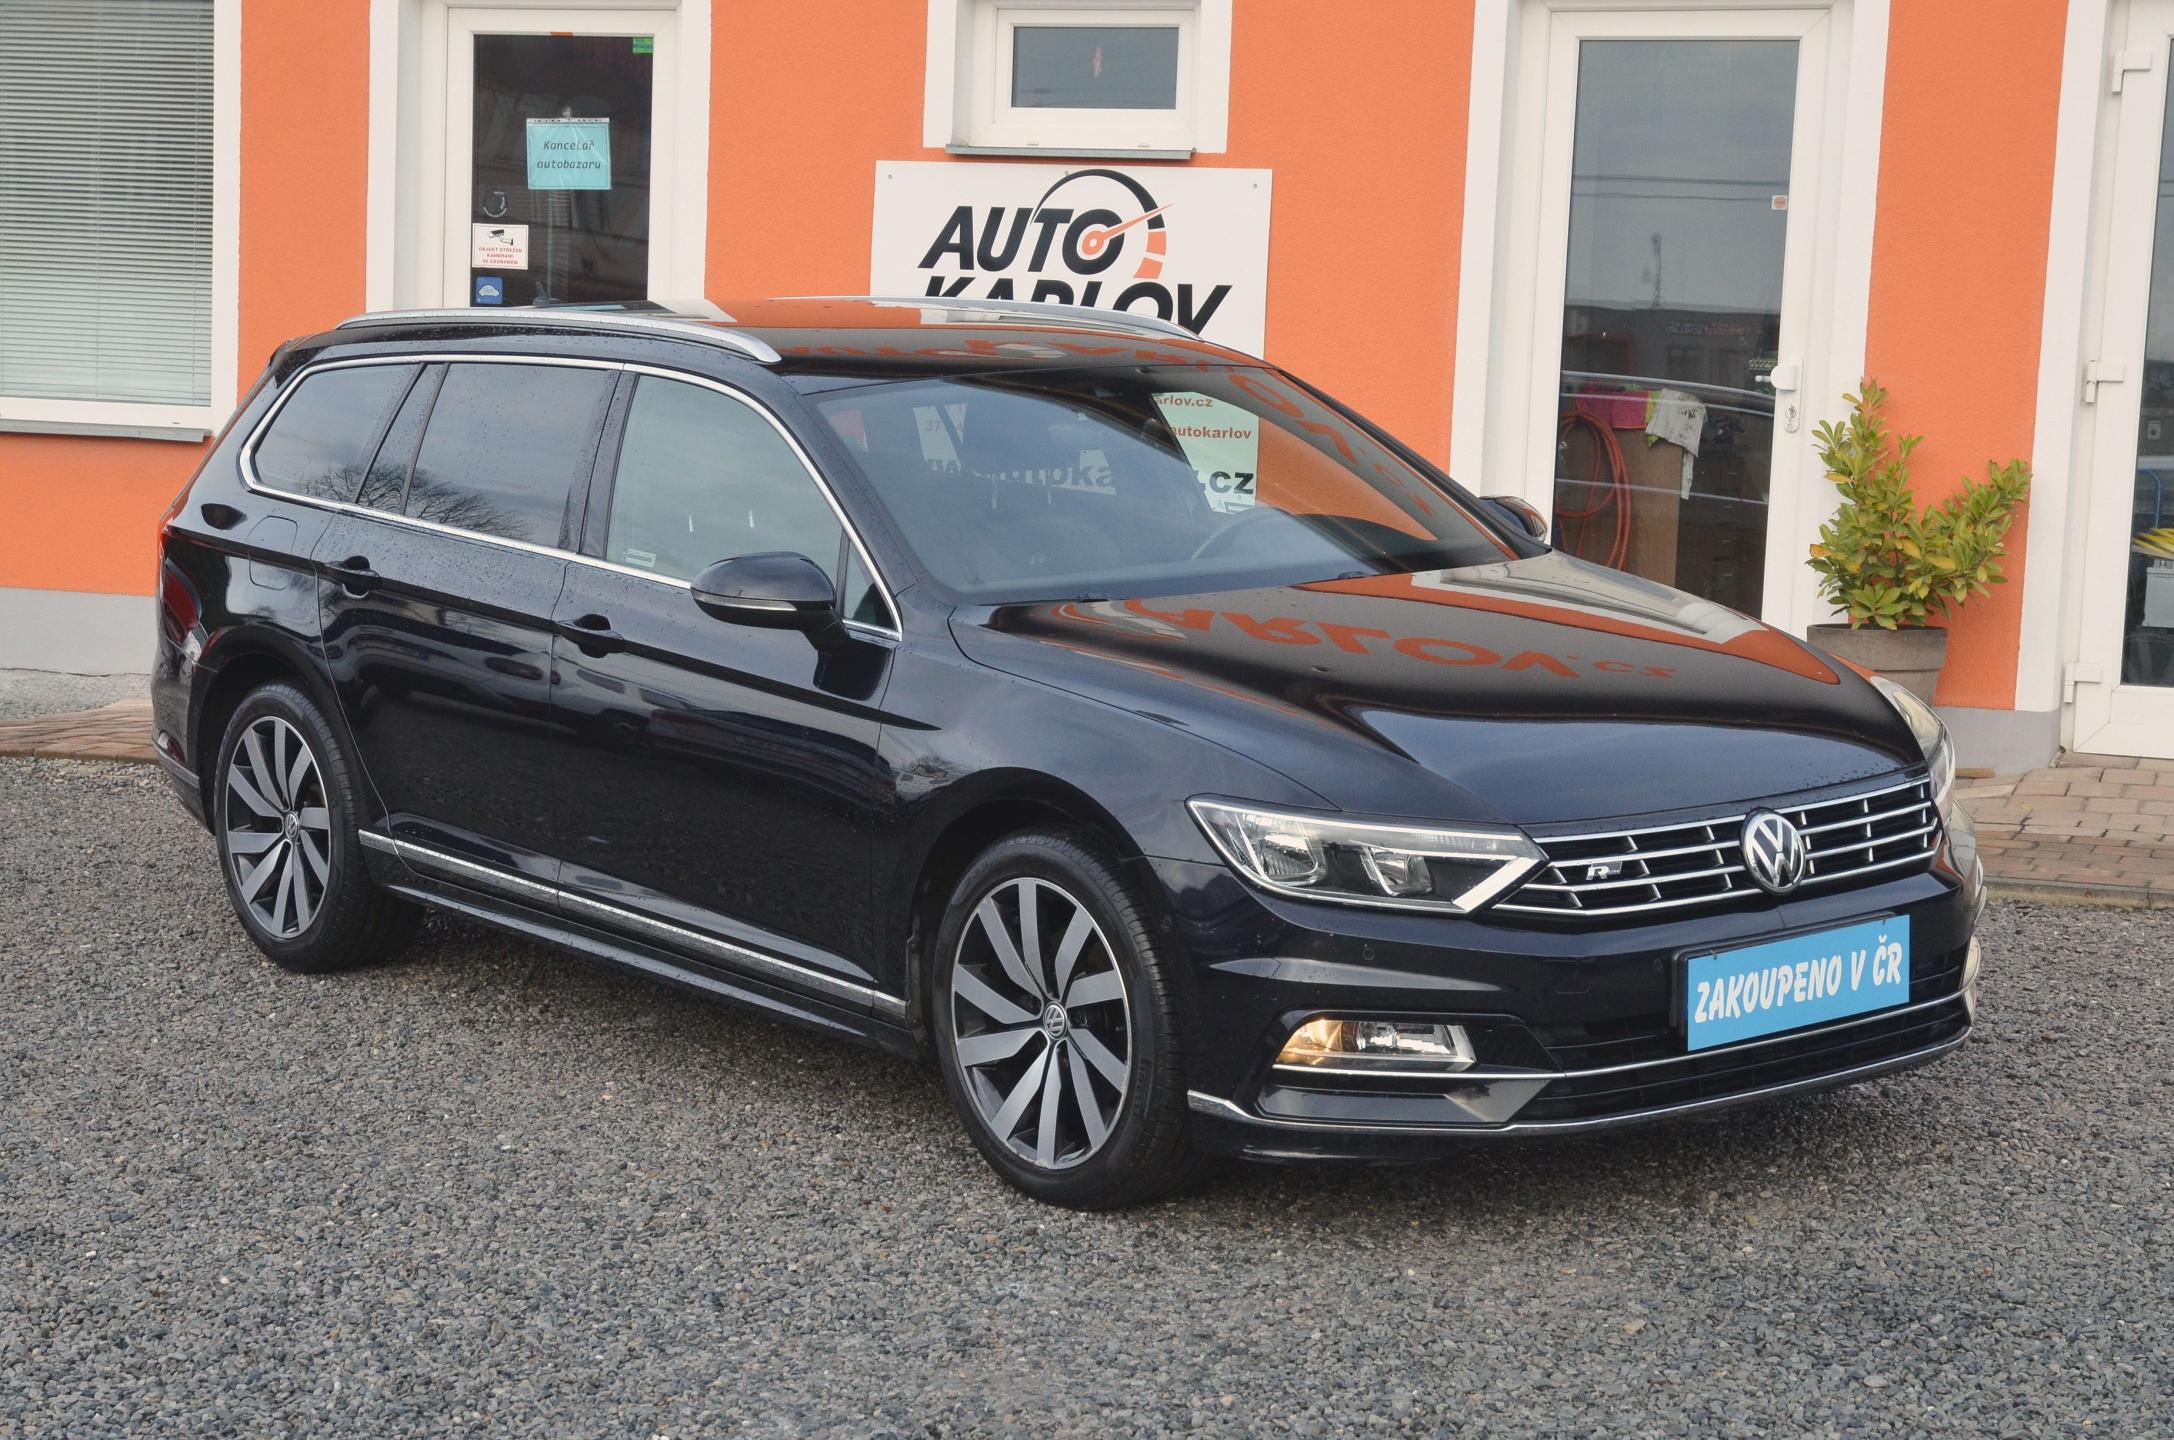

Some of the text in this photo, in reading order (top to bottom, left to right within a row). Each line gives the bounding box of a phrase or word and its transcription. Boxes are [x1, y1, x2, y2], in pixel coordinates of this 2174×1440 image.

[537, 160, 601, 169] autobazaru
[917, 205, 1125, 275] AUTO
[1155, 394, 1214, 408] arlov.cz
[1694, 935, 1904, 1024] ZAKOUPENO V ČR
